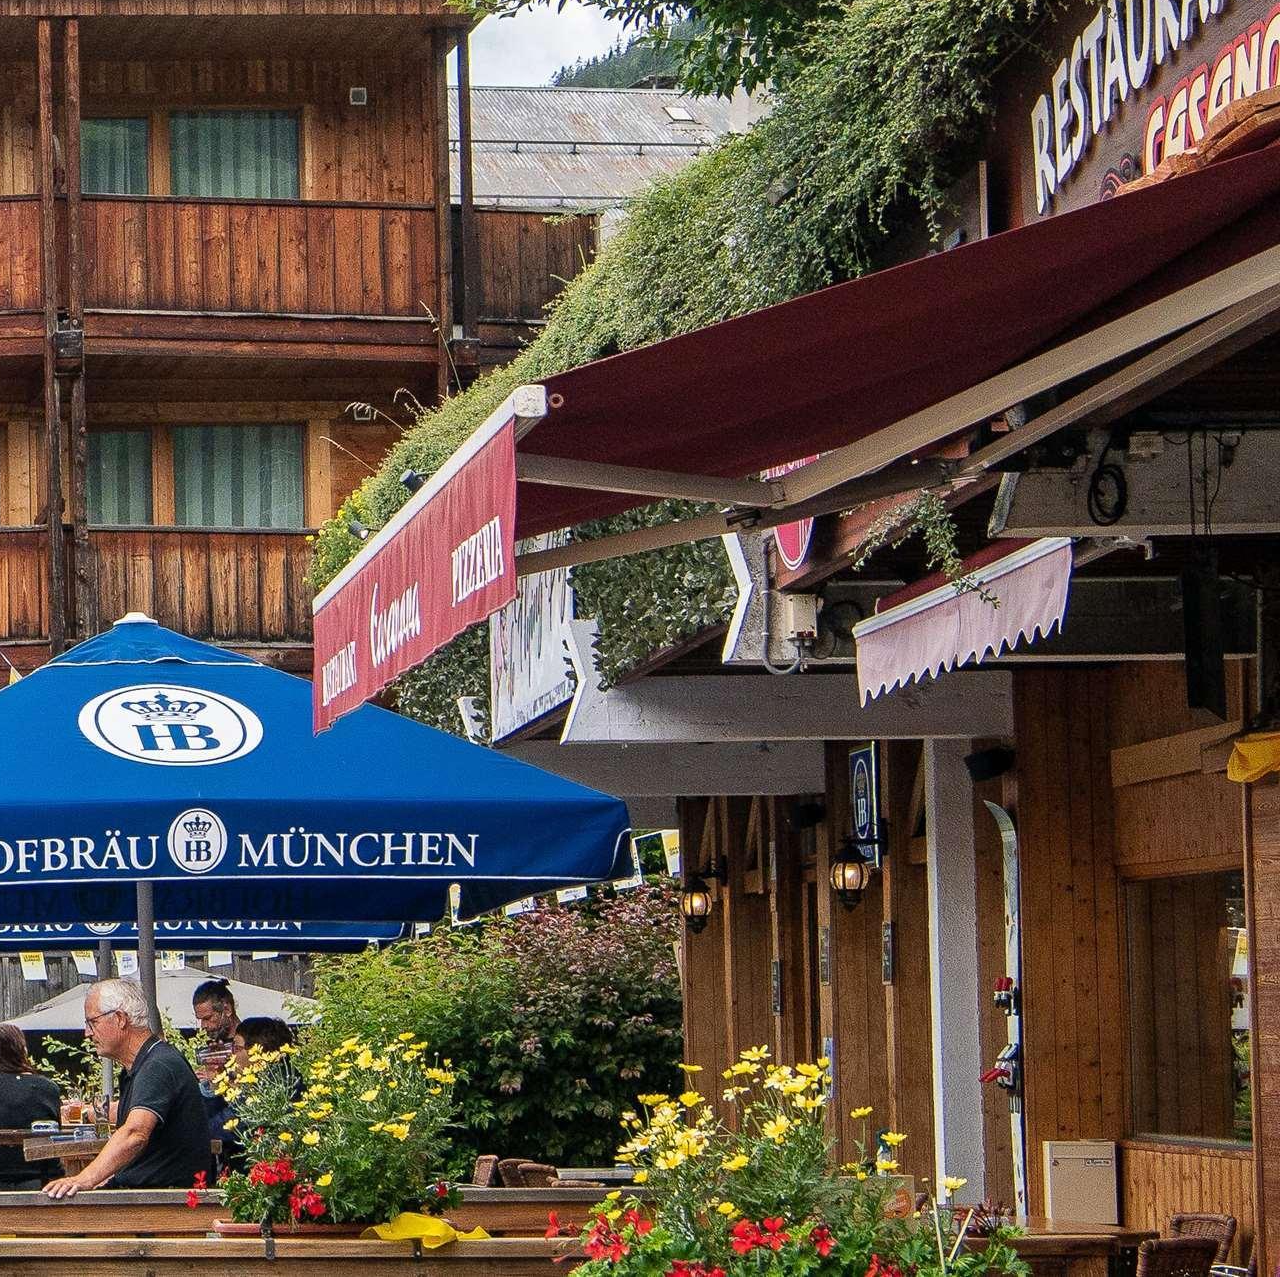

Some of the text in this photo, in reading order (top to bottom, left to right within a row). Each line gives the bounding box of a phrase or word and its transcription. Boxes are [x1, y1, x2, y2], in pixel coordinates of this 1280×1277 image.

[451, 515, 504, 608] PIZZERIA
[132, 723, 221, 751] HB
[184, 839, 213, 863] HB
[237, 827, 480, 868] MÜNCHEN
